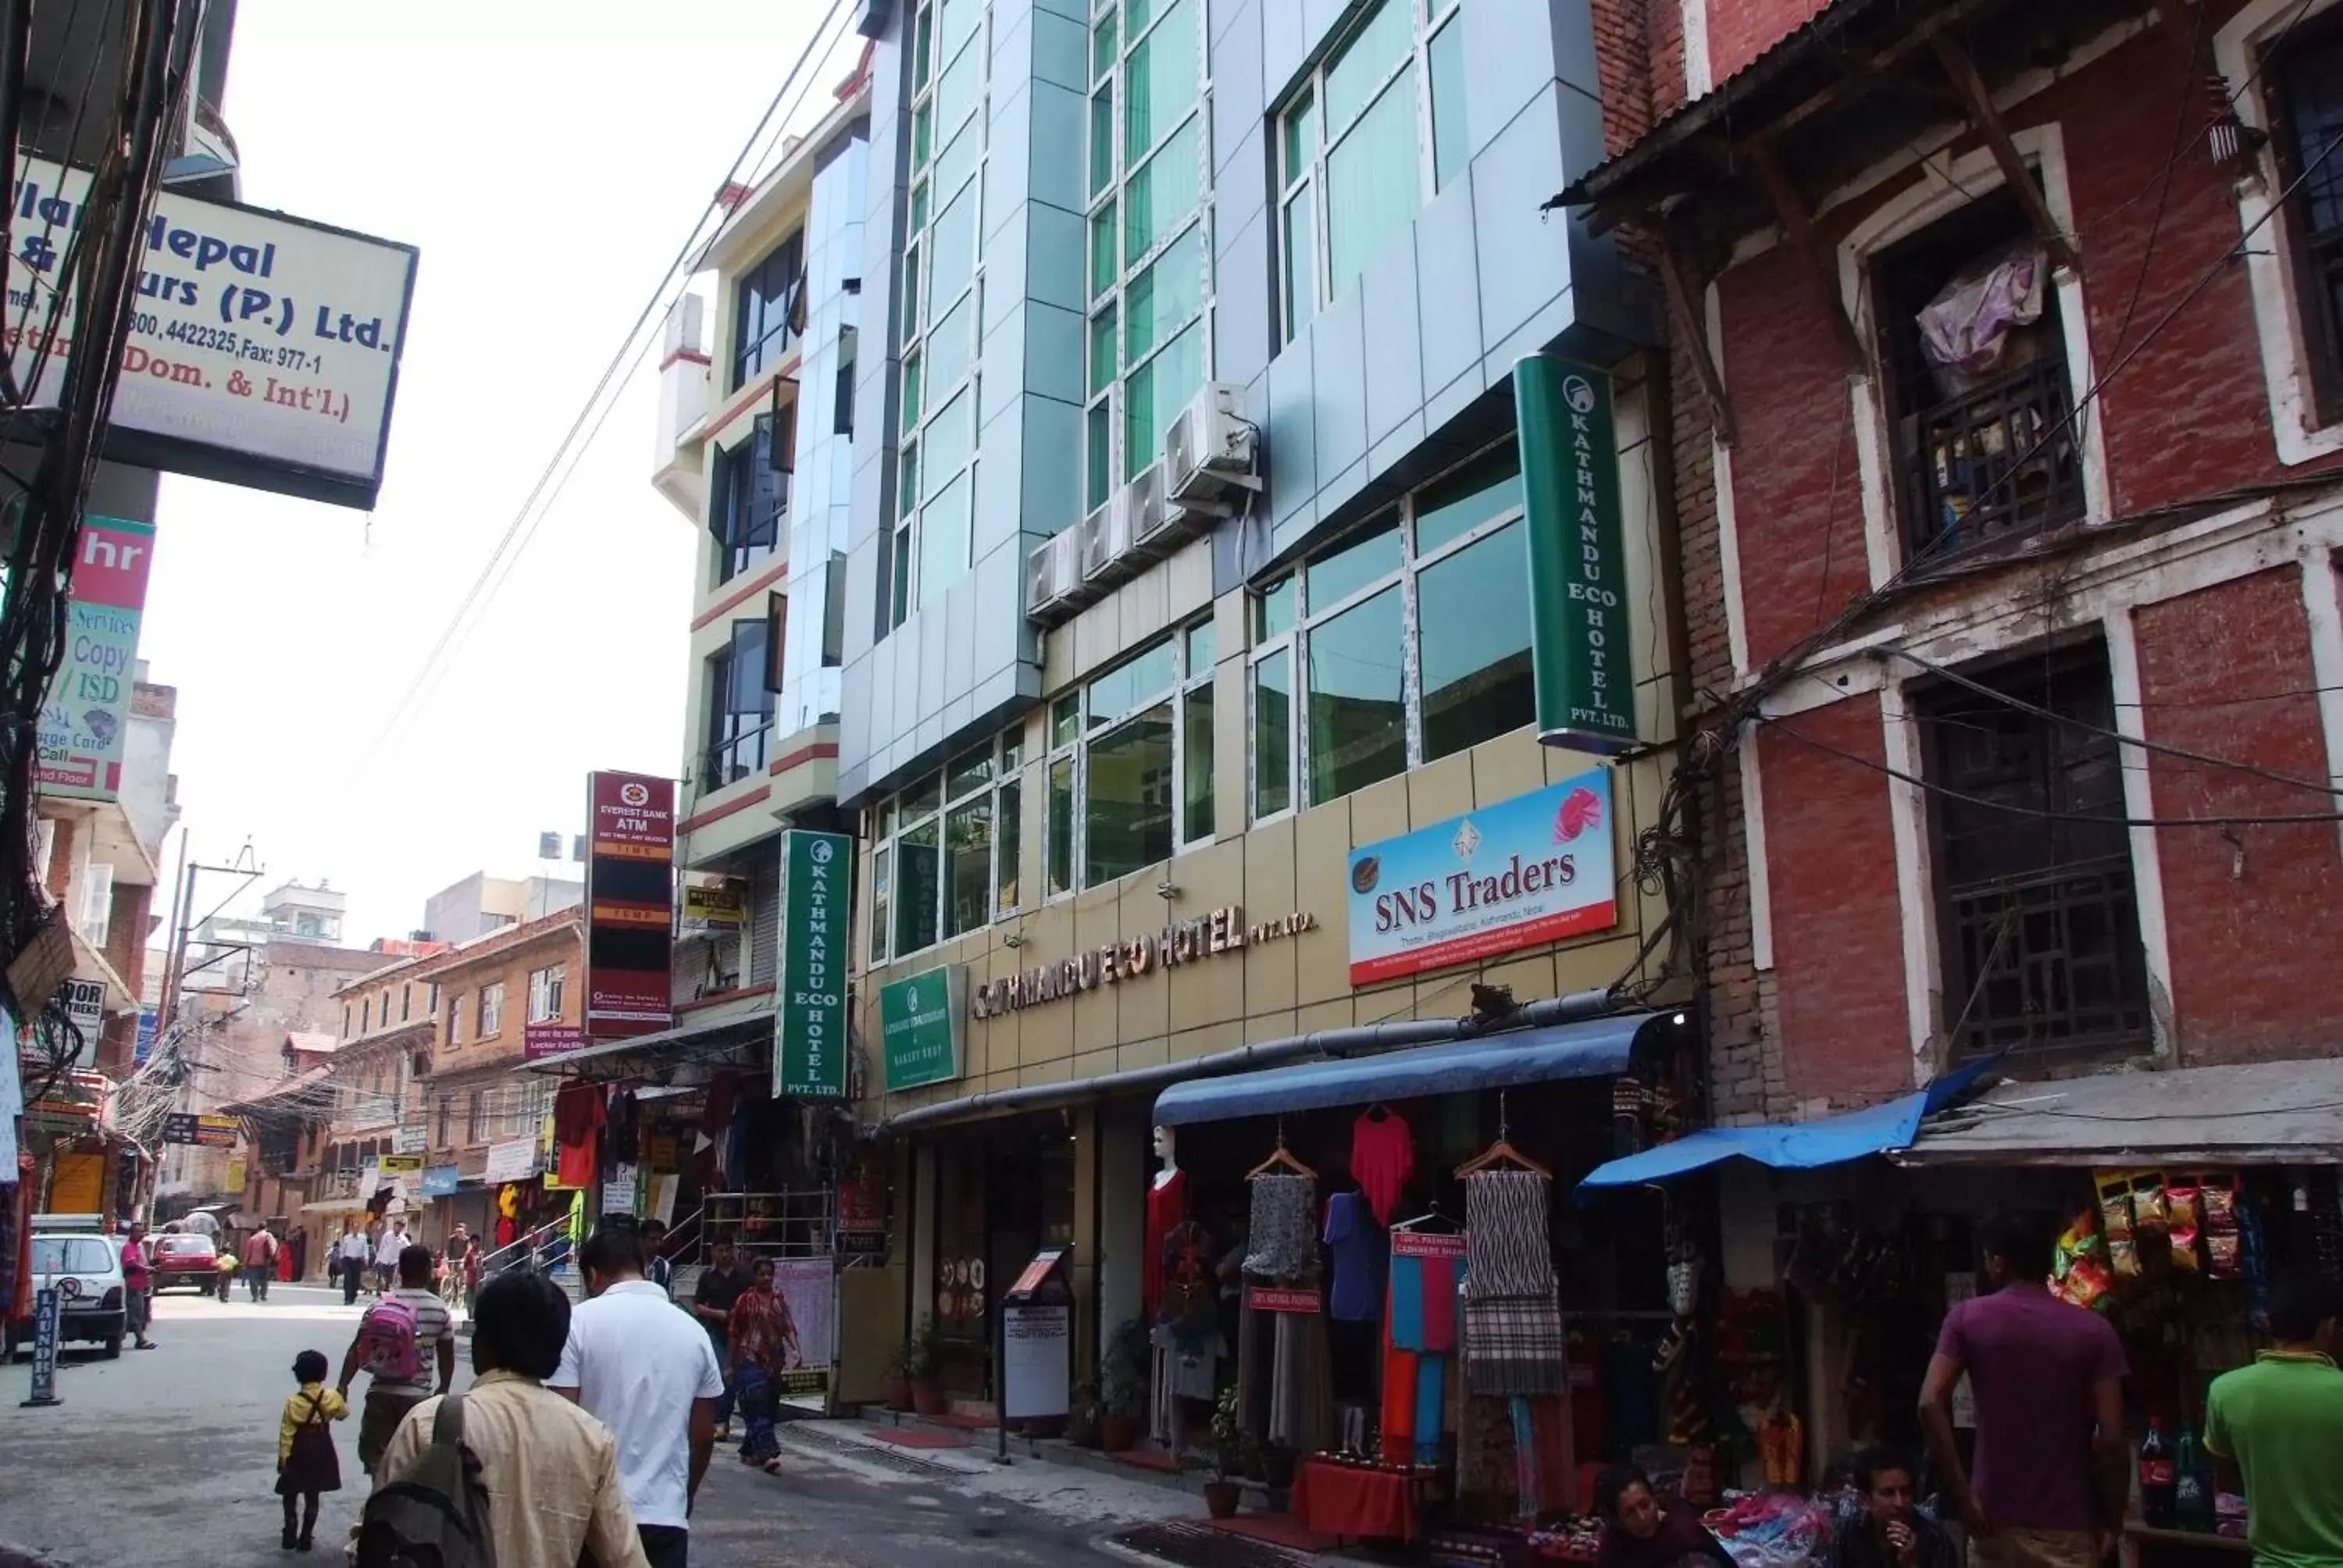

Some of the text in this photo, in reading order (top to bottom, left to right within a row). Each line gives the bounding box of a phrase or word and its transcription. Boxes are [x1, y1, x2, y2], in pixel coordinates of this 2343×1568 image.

[20, 235, 57, 273] &
[219, 283, 294, 337] (P.)
[314, 305, 390, 352] Ltd.
[123, 345, 211, 389] Dom.
[226, 369, 253, 397] &
[276, 347, 322, 374] 977-1
[1570, 412, 1601, 583] KATHMANDU
[1567, 582, 1617, 608] ECO
[73, 635, 130, 675] Copy
[1585, 607, 1608, 709] HOTEL
[1570, 707, 1630, 730] PVT. LTD.
[600, 805, 669, 820] EVEREST BANK
[615, 818, 648, 832] ATM
[617, 844, 651, 855] TIME
[1375, 853, 1576, 933] SNS Traders
[810, 865, 828, 989] KATHMANDU
[1100, 932, 1154, 984] ECO
[1158, 905, 1246, 969] HOTEL
[794, 992, 838, 1007] ECO
[808, 1010, 824, 1082] HOTEL
[815, 1085, 840, 1095] LTD.
[33, 1292, 53, 1387] LAUNDRY
